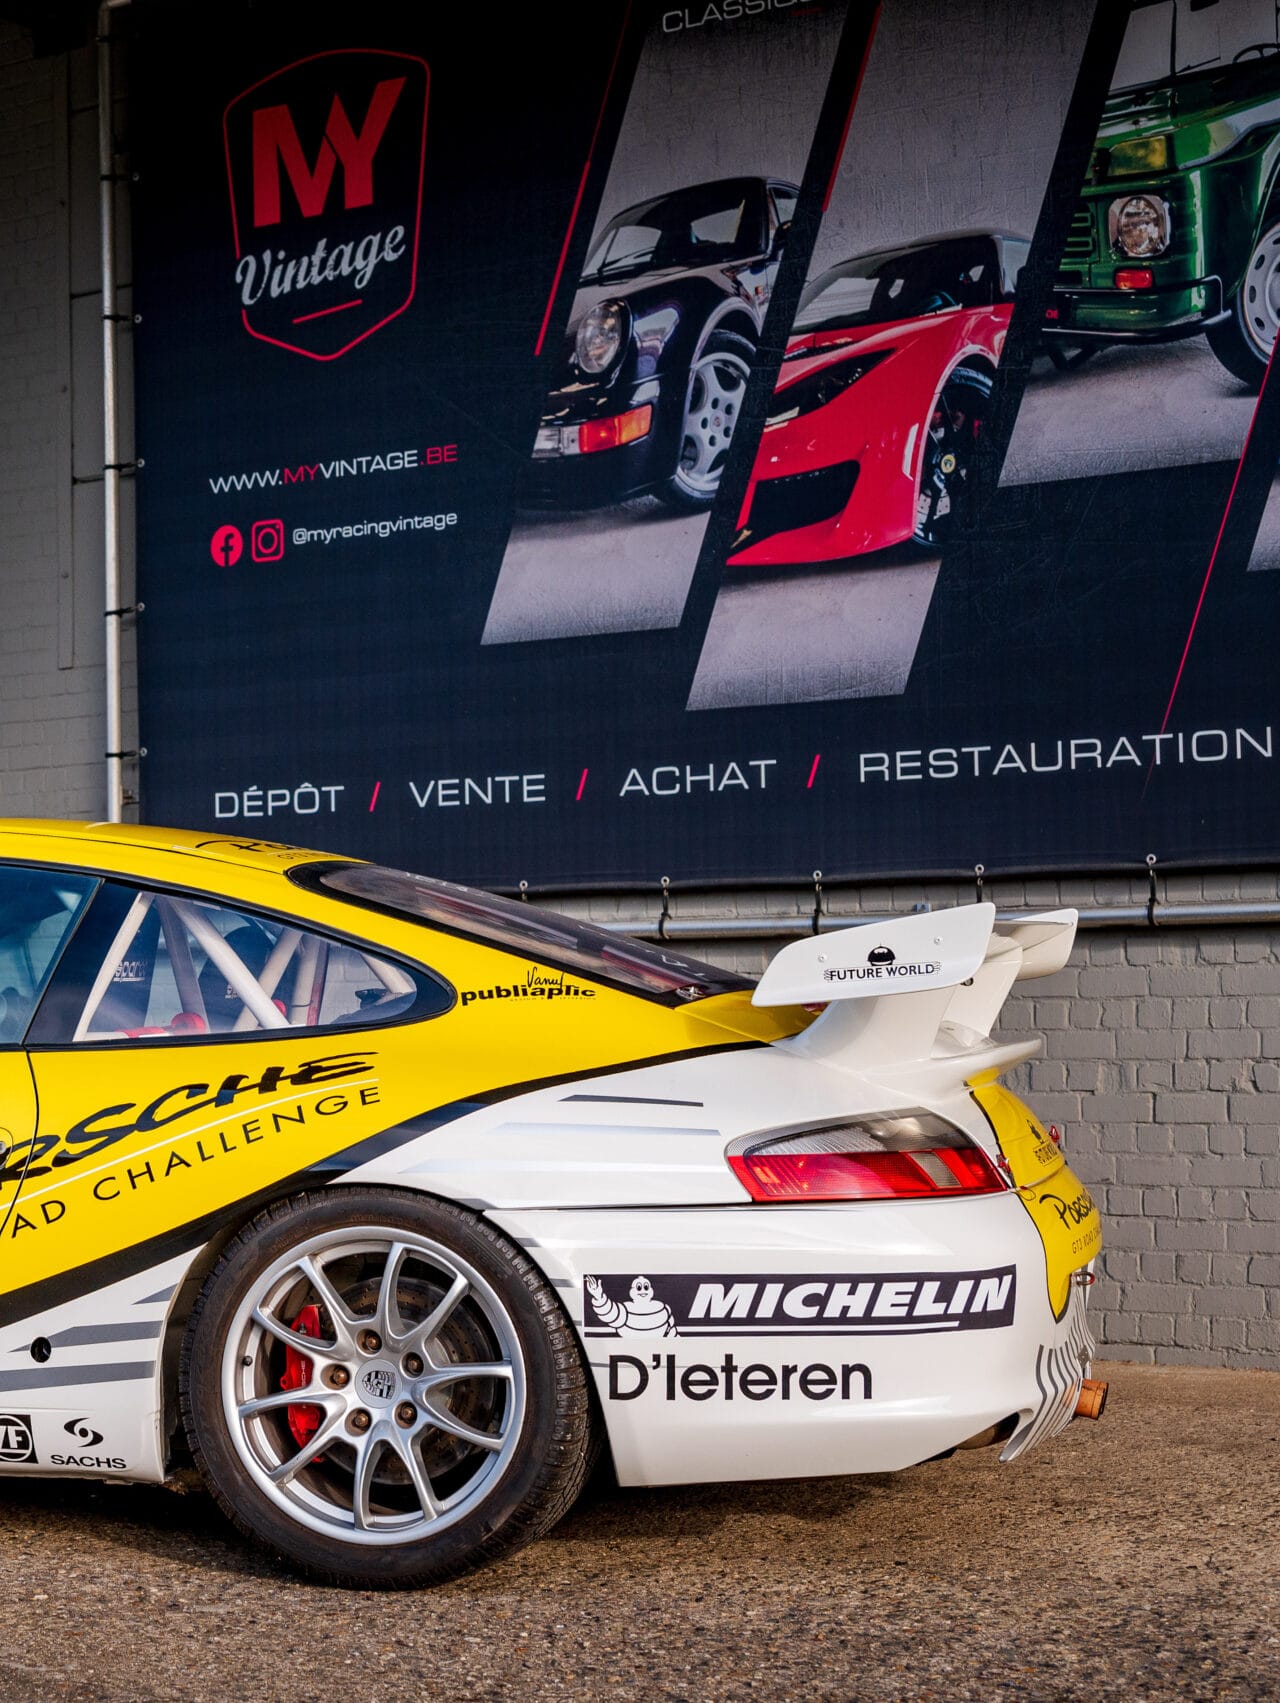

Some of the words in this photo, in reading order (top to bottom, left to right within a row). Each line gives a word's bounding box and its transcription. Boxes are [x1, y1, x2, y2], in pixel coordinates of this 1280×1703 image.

[252, 76, 407, 228] MY
[235, 224, 406, 307] Vintage
[209, 444, 458, 493] WWW.MYVINTAGE.BE
[292, 512, 458, 545] @myracingvintage
[214, 784, 345, 818] DÉPÔT
[409, 774, 546, 808] VENTE
[619, 759, 776, 797] ACHAT
[859, 726, 1272, 783] RESTAURATION
[830, 968, 882, 981] FUTURE
[886, 963, 935, 976] WORLD
[94, 1086, 381, 1201] CHALLENGE
[687, 1275, 1013, 1319] MICHELIN
[609, 1353, 873, 1400] D'Ieteren
[50, 1454, 127, 1469] SACHS
